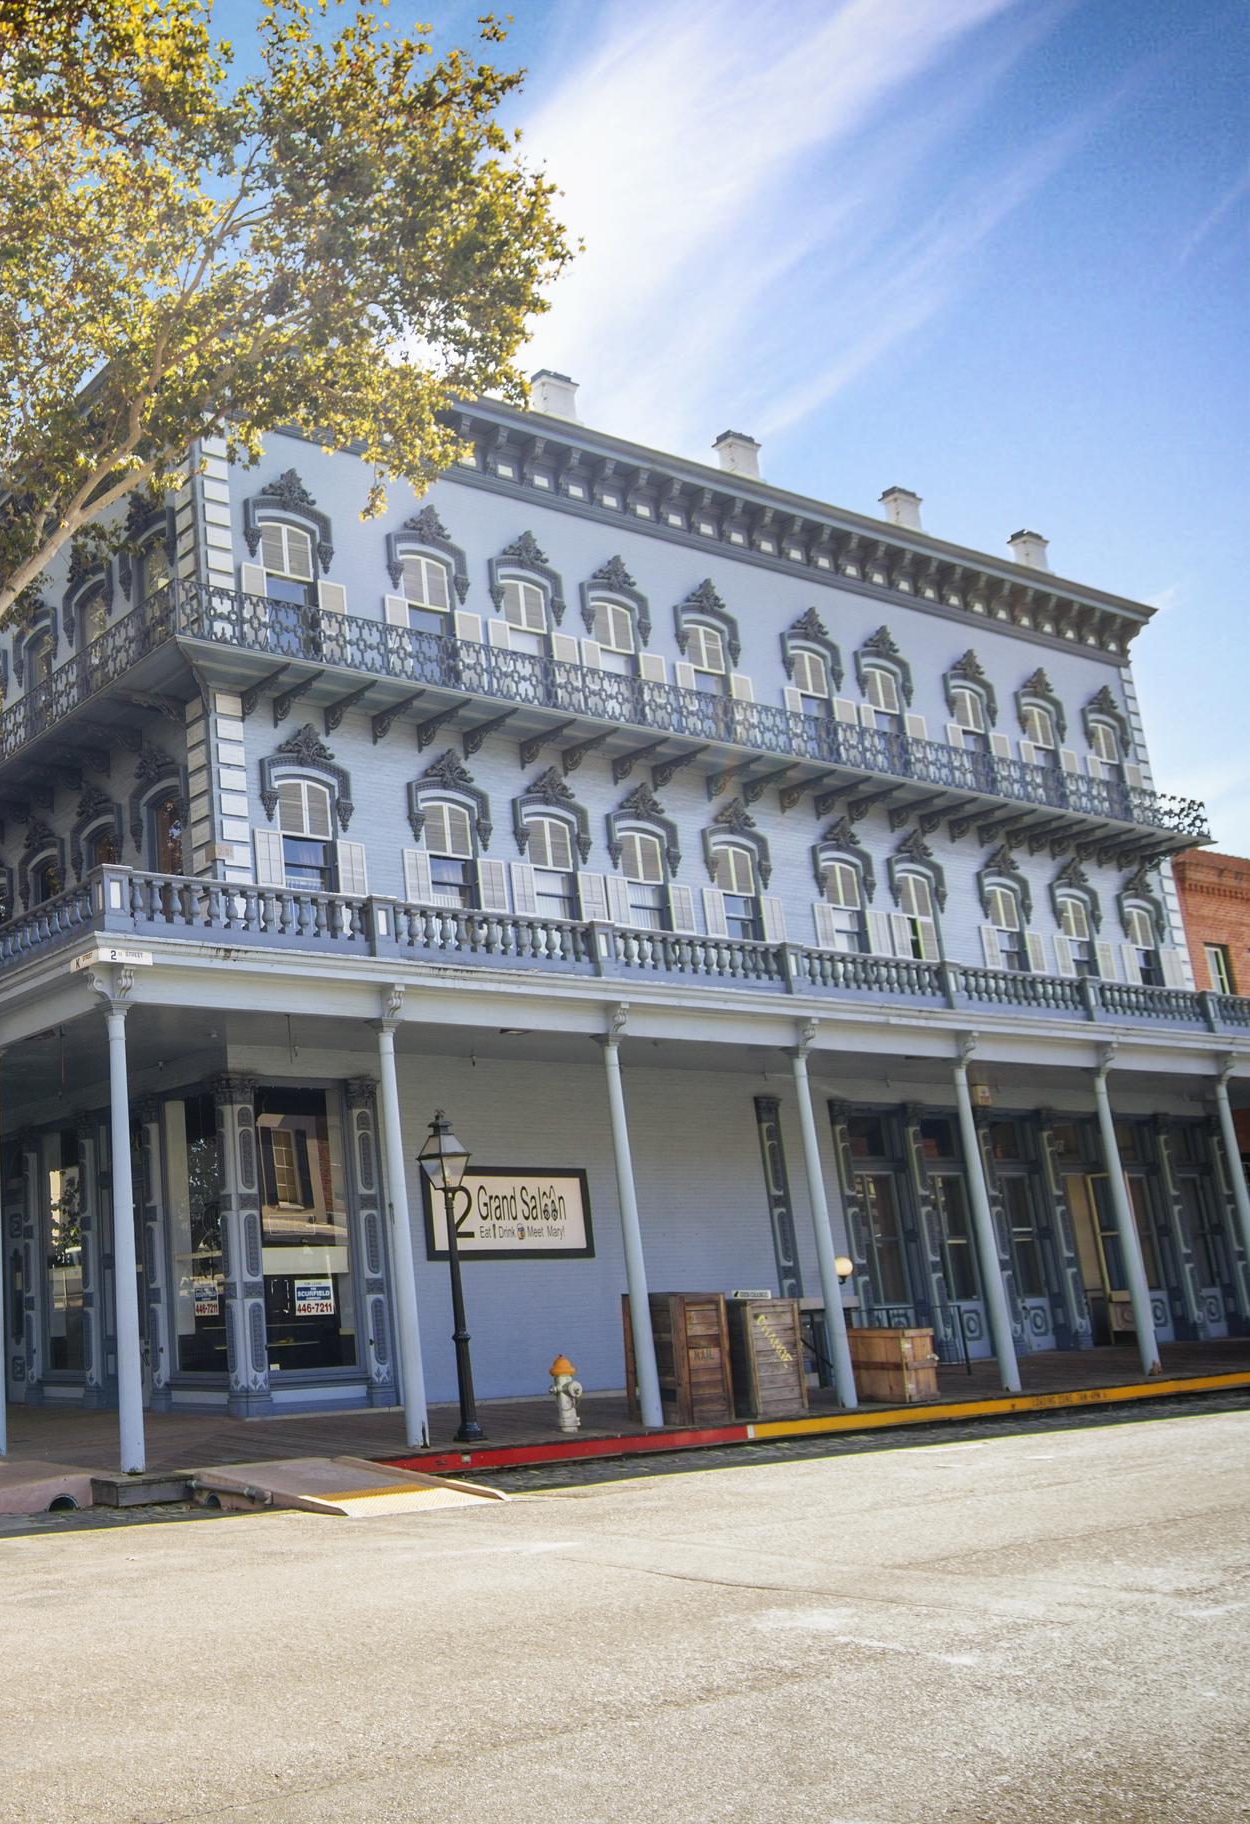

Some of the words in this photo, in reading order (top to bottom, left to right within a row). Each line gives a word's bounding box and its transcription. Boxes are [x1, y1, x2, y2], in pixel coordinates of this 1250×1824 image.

[111, 950, 117, 960] 2
[76, 958, 81, 969] K
[477, 1185, 518, 1221] Grand
[480, 1226, 492, 1239] Eat
[499, 1226, 516, 1239] Drink
[527, 1226, 544, 1238] Meet
[547, 1226, 566, 1240] Mary!
[297, 1290, 330, 1298] SCURFIELD
[297, 1302, 332, 1313] 446-7211
